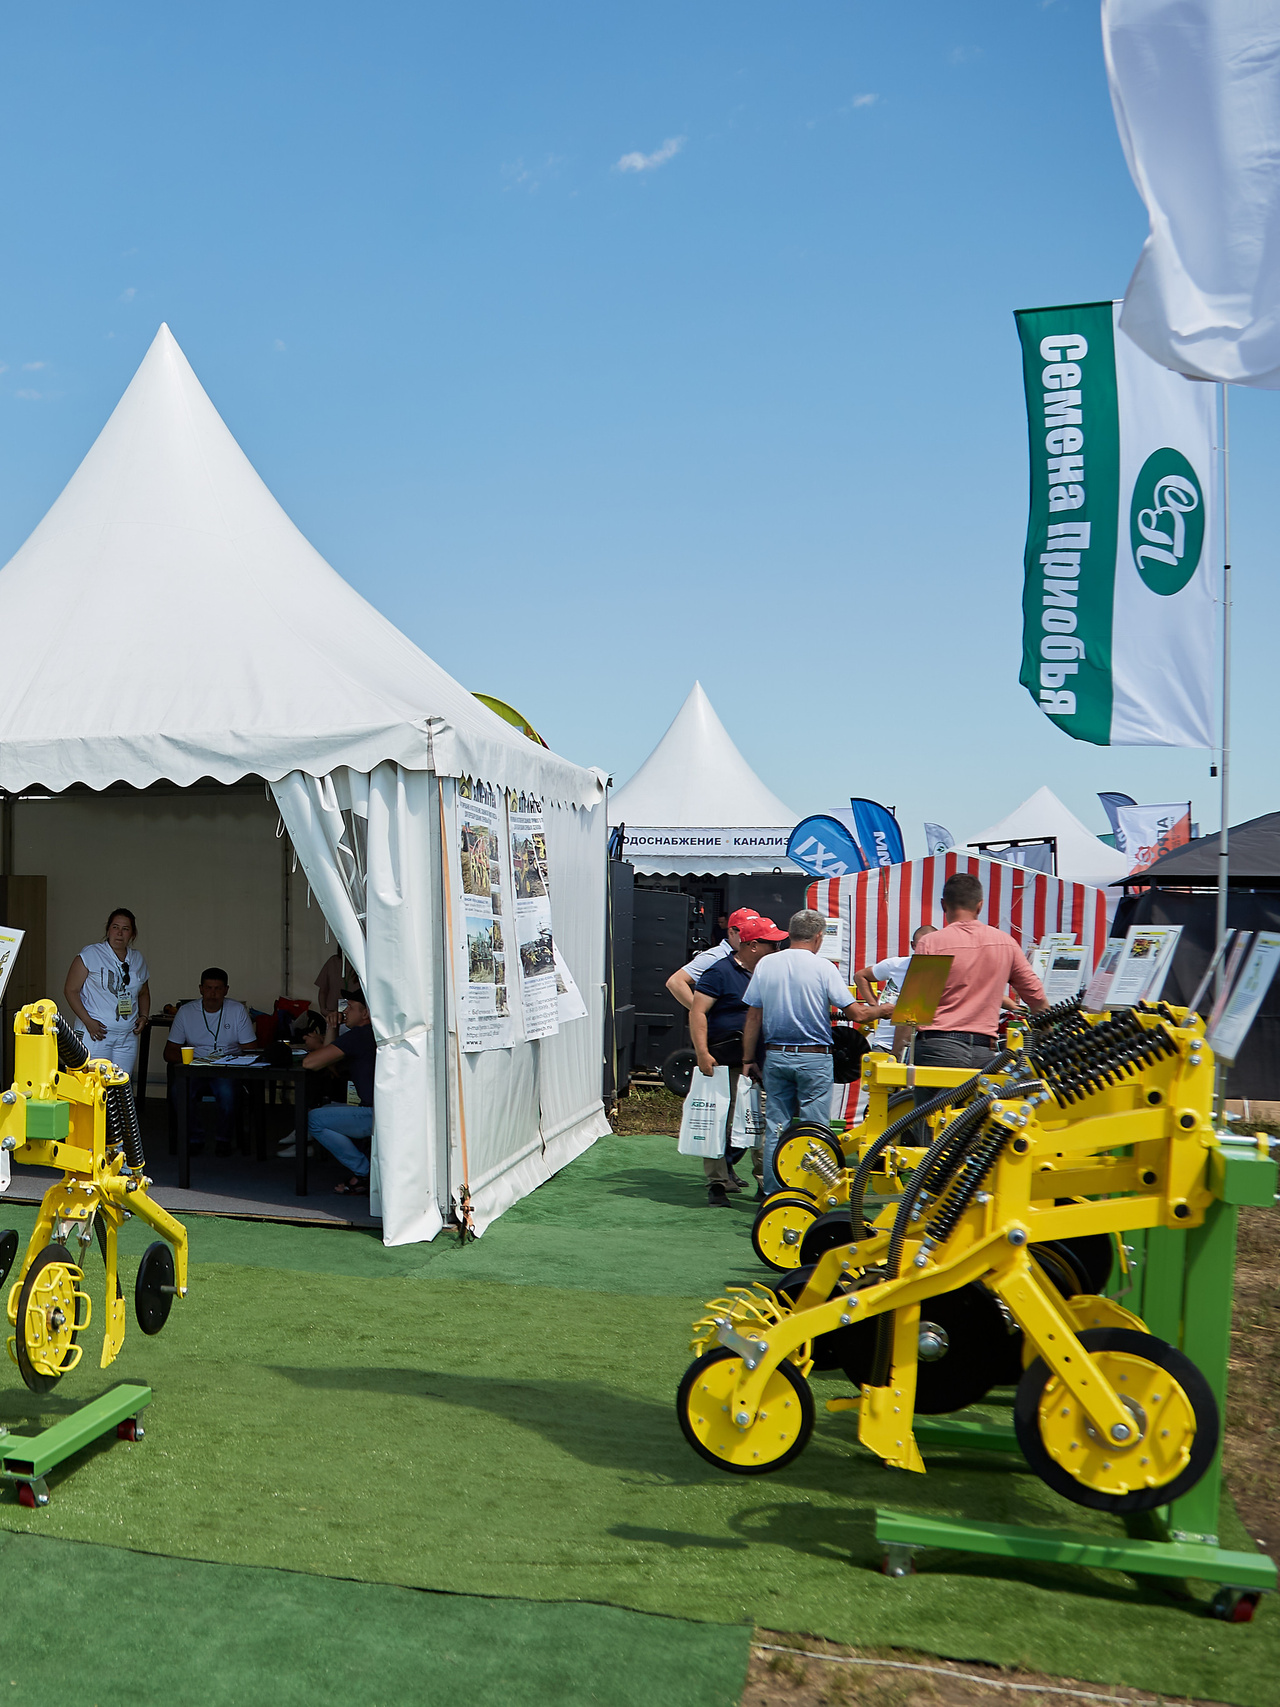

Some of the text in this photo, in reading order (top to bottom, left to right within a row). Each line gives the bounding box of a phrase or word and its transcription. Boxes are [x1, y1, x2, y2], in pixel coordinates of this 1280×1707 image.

[1039, 333, 1089, 514] Семена
[1038, 521, 1091, 716] Приобья
[623, 836, 790, 846] ОДОСНАБЖЕНИЕ КАНАЛИЗ
